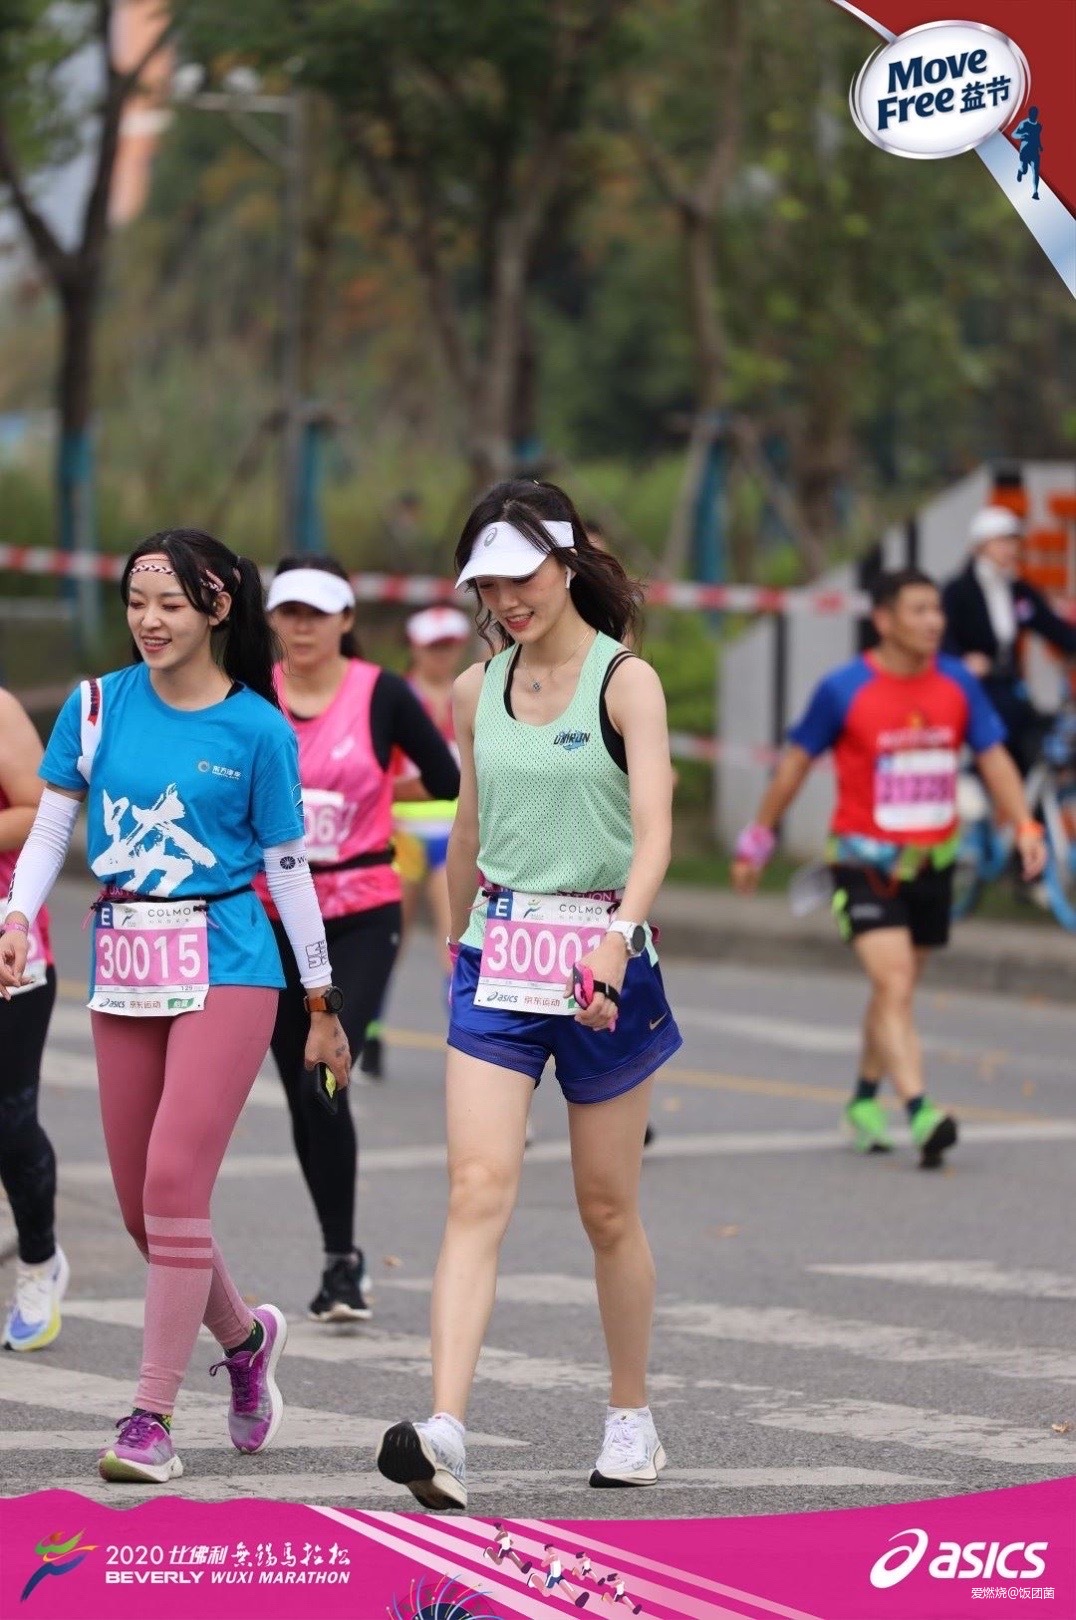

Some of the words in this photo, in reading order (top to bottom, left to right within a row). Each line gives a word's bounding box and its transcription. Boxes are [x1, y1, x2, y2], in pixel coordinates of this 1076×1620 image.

[101, 907, 111, 926] E
[147, 907, 191, 918] COLMO
[495, 897, 510, 917] E
[559, 903, 603, 917] COLMO
[99, 934, 201, 980] 30015
